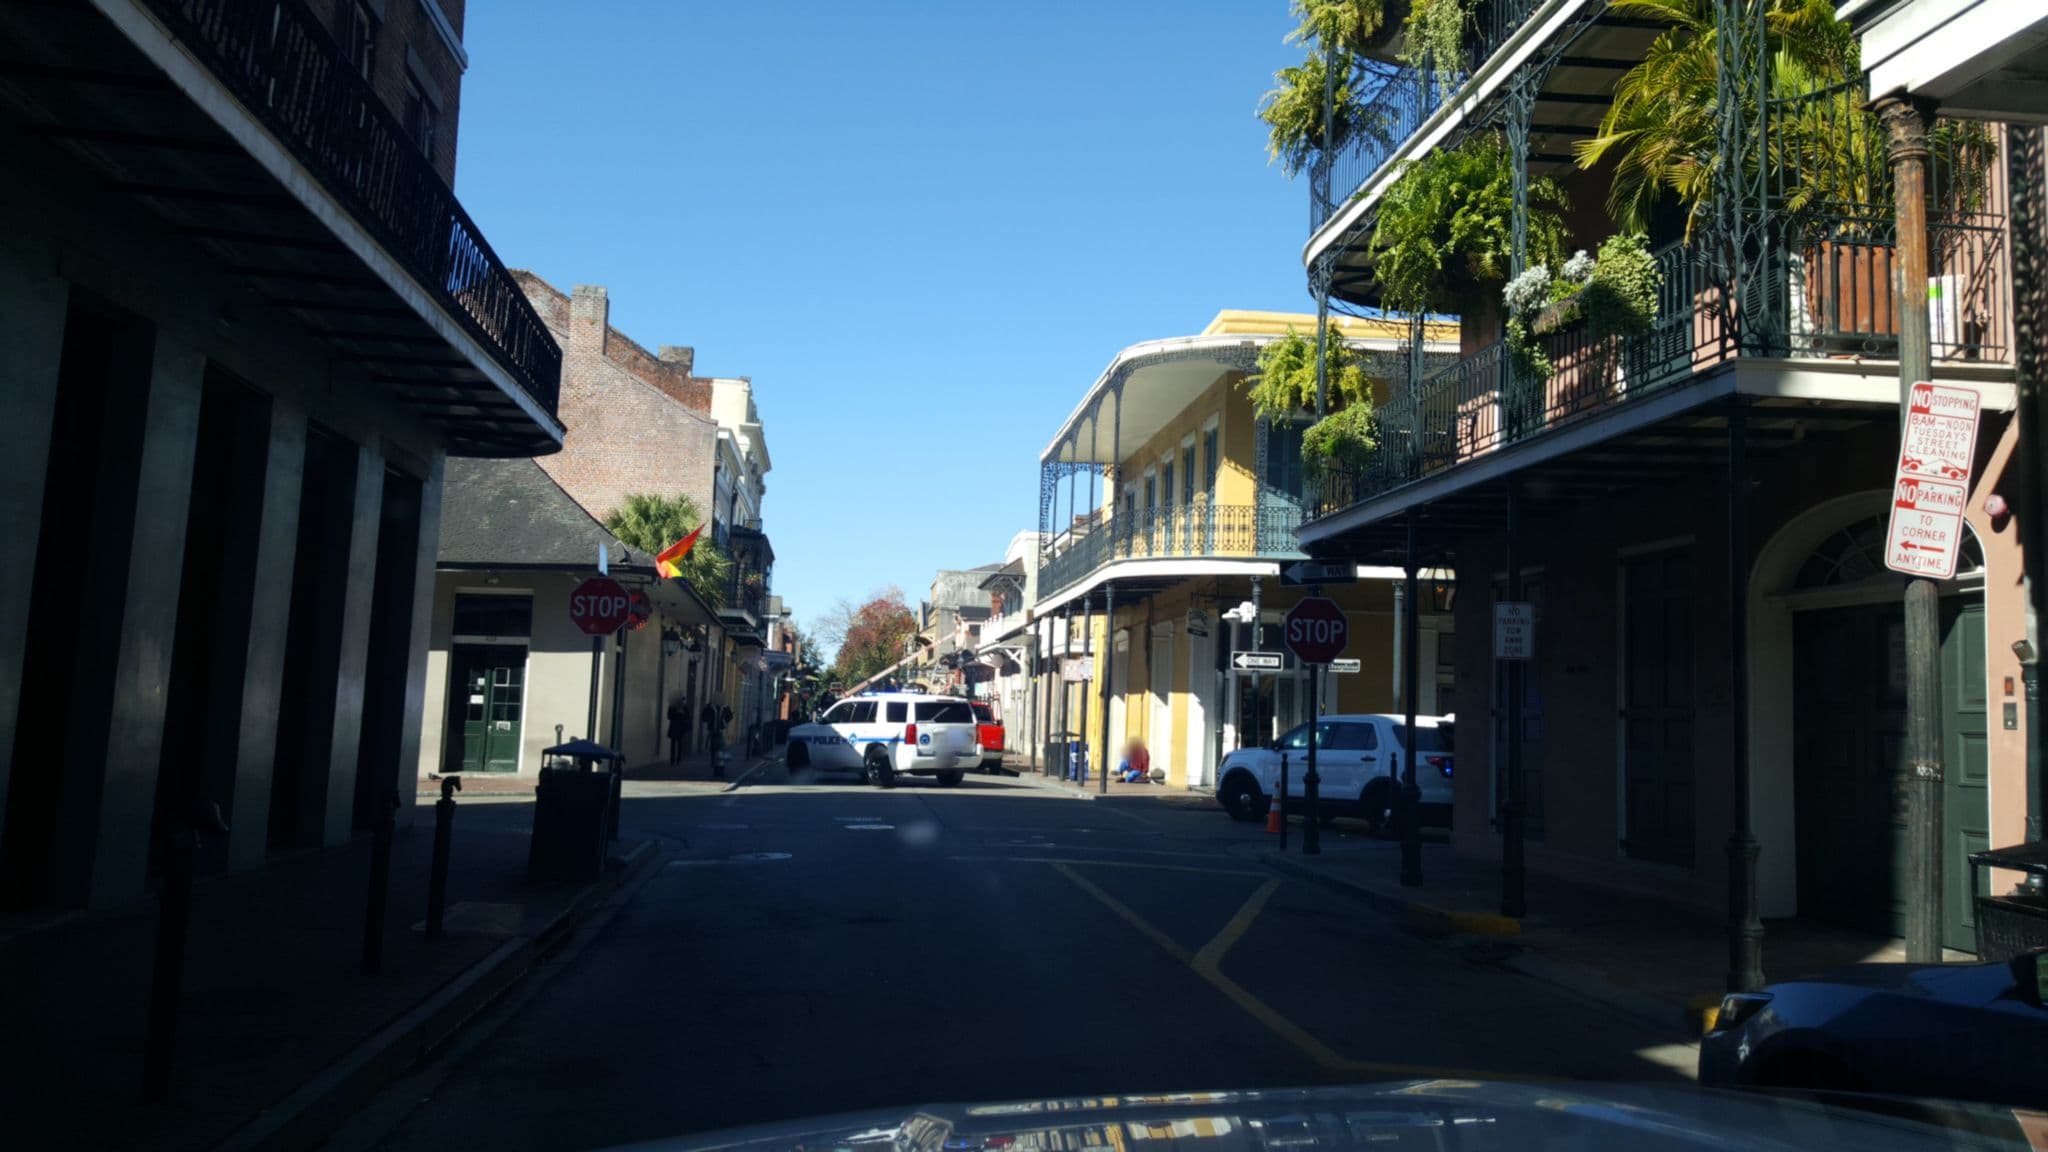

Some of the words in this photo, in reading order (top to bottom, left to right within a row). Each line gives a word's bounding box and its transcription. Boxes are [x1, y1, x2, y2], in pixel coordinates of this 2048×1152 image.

[1911, 388, 1931, 408] NO
[1932, 395, 1976, 410] STOPPING
[1913, 426, 1968, 442] TUESDAYS
[1917, 437, 1958, 450] STREET
[1908, 445, 1967, 461] CLEANING
[1896, 481, 1916, 503] NO
[1917, 489, 1962, 507] PARKING
[1920, 515, 1933, 526] TO
[1902, 526, 1946, 541] CORNER
[1896, 553, 1944, 569] ANYTIME
[573, 594, 627, 618] STOP
[1508, 607, 1520, 616] NO
[1290, 617, 1344, 645] STOP
[1247, 657, 1259, 665] ONE
[1263, 657, 1277, 665] WAY
[812, 735, 841, 745] POLICE
